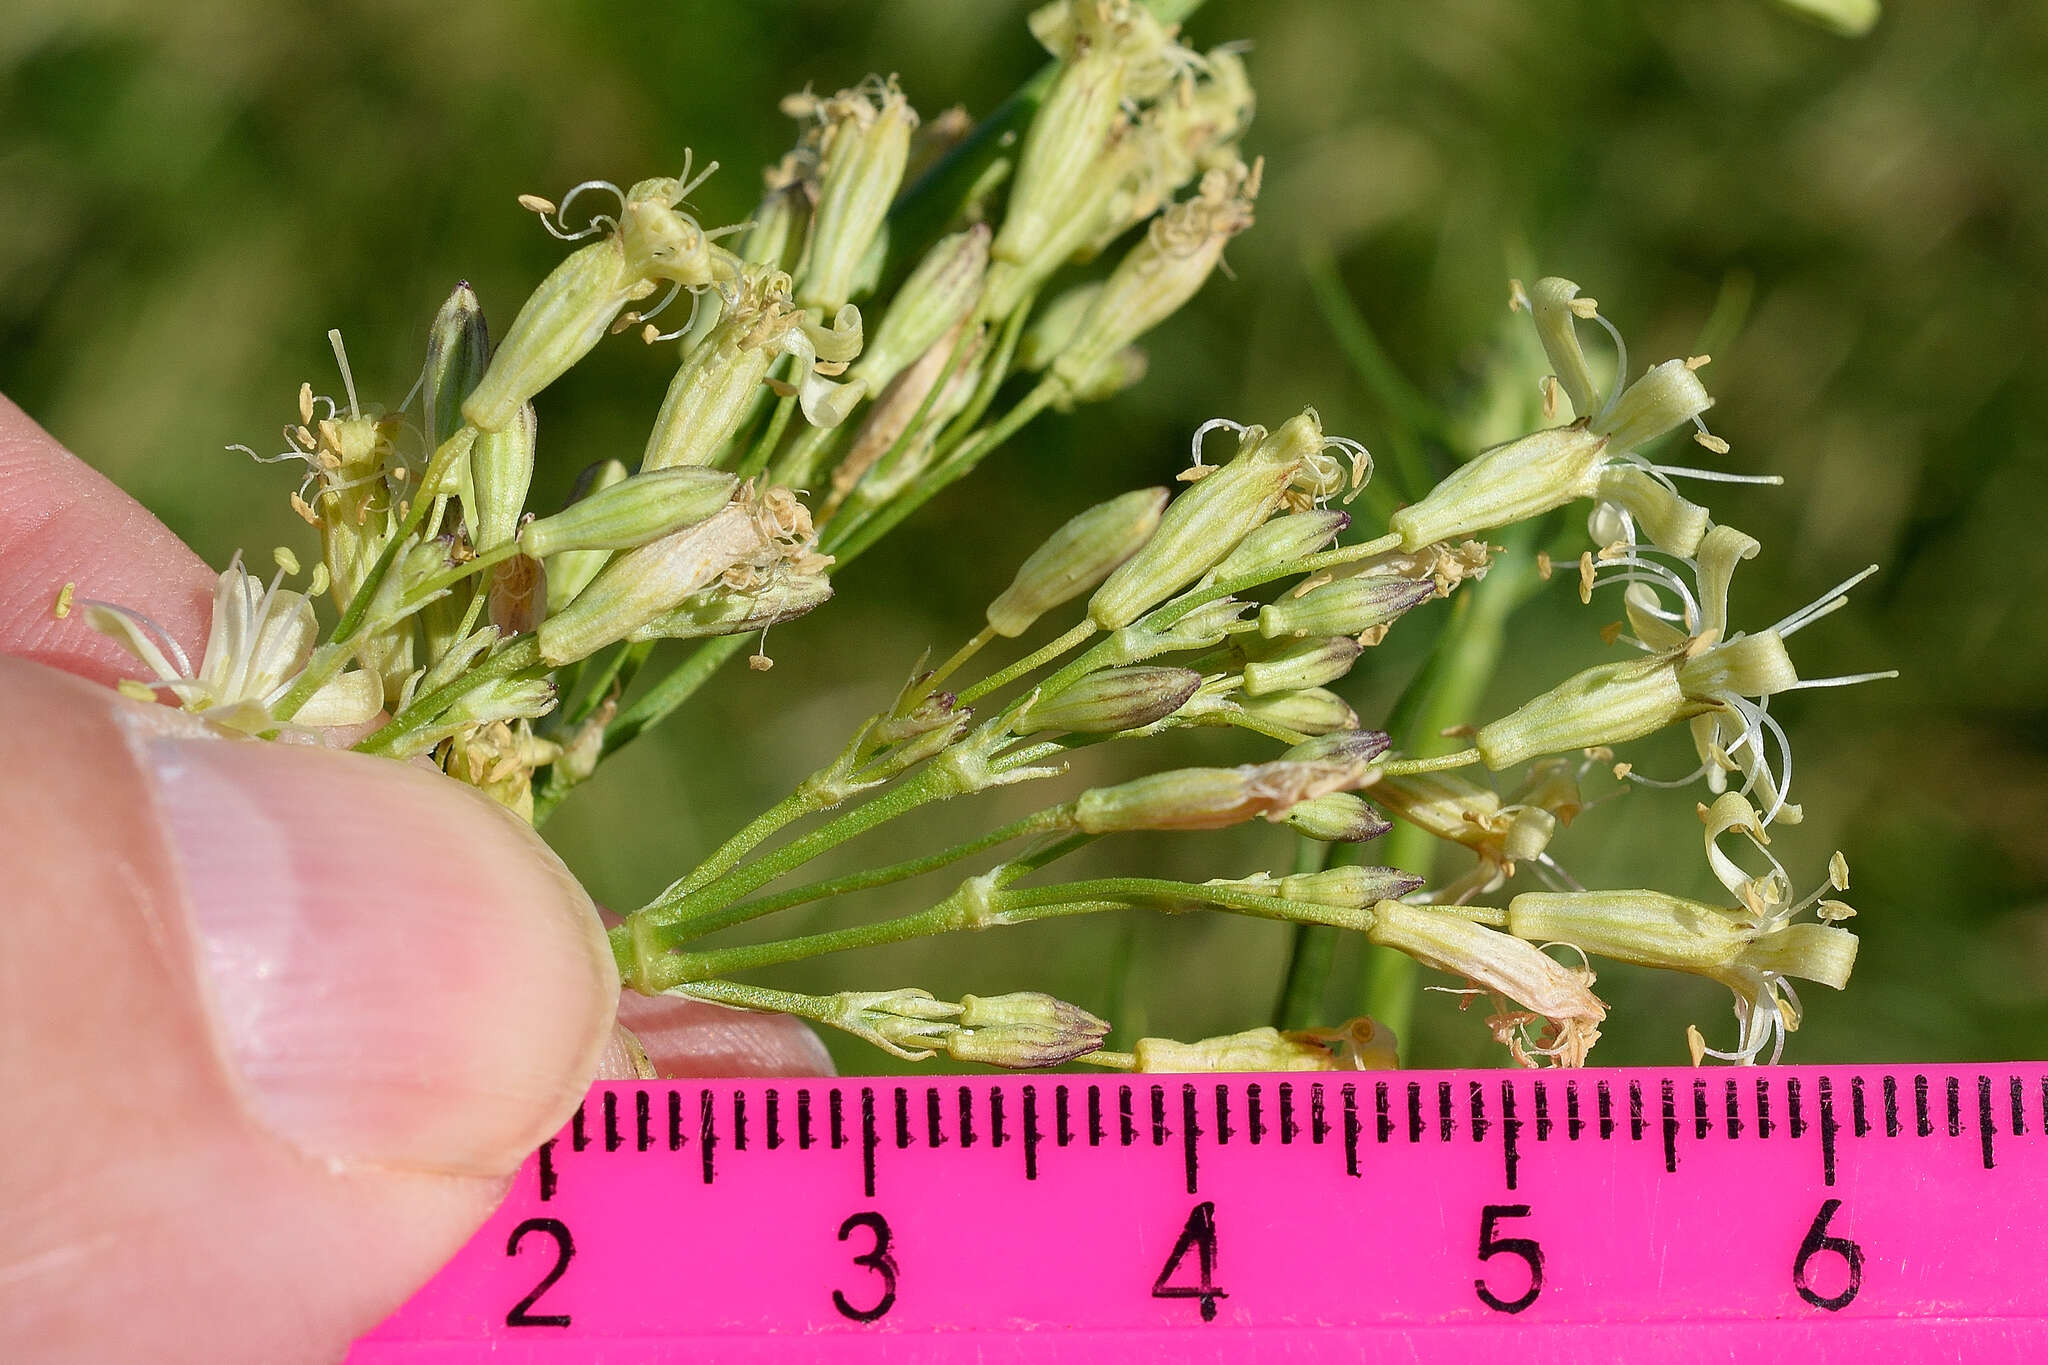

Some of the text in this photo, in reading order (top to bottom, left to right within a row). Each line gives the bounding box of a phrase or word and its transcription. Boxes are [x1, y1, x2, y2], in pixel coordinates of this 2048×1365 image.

[507, 1200, 1864, 1327] 2 3 4 5 6
